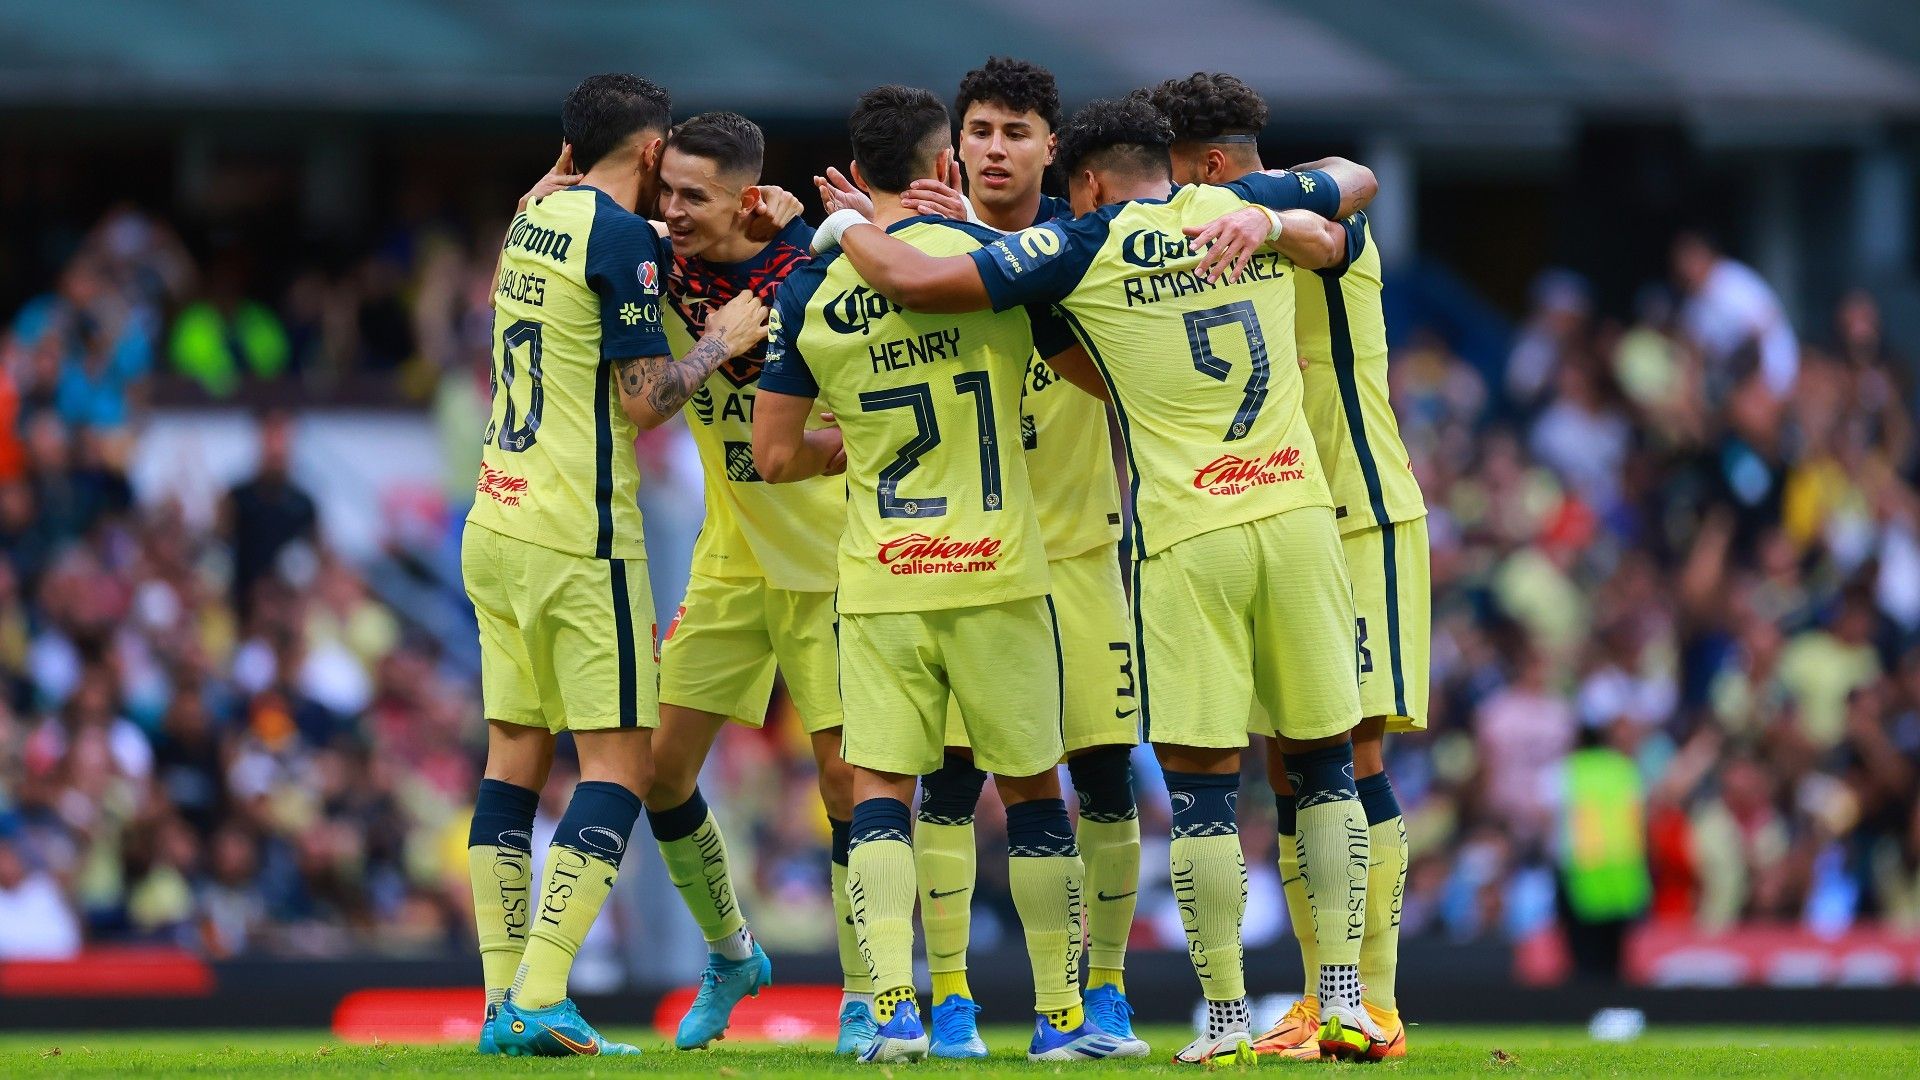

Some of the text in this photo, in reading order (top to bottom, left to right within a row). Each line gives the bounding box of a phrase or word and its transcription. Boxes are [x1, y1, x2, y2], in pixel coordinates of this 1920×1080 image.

[868, 327, 960, 374] HENRY
[1182, 299, 1271, 443] 9
[484, 319, 545, 453] 0
[721, 392, 756, 424] AT
[858, 370, 1003, 519] 21
[877, 533, 1002, 565] Caliente
[890, 559, 997, 576] caliente.mx
[1108, 642, 1136, 698] 3
